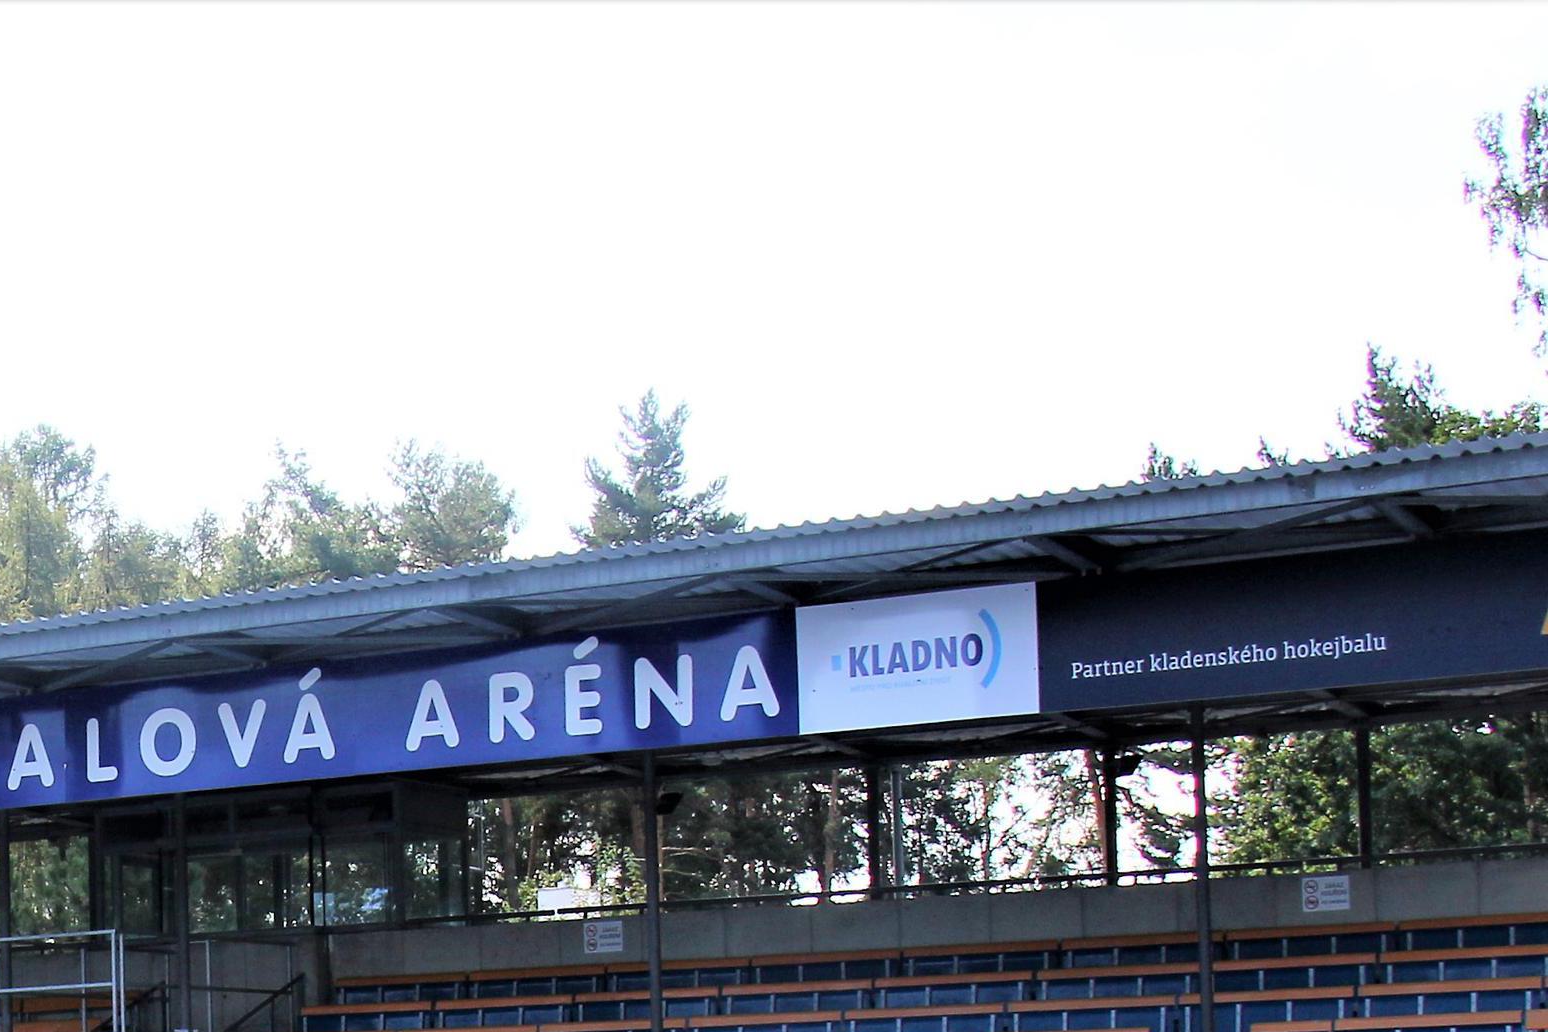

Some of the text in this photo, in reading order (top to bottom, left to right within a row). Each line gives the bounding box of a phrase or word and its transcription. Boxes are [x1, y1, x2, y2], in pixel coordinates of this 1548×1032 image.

[848, 633, 984, 678] KLADNO
[1071, 633, 1387, 679] Partner kladenského hokejbalu
[406, 636, 780, 753] ARÉNA
